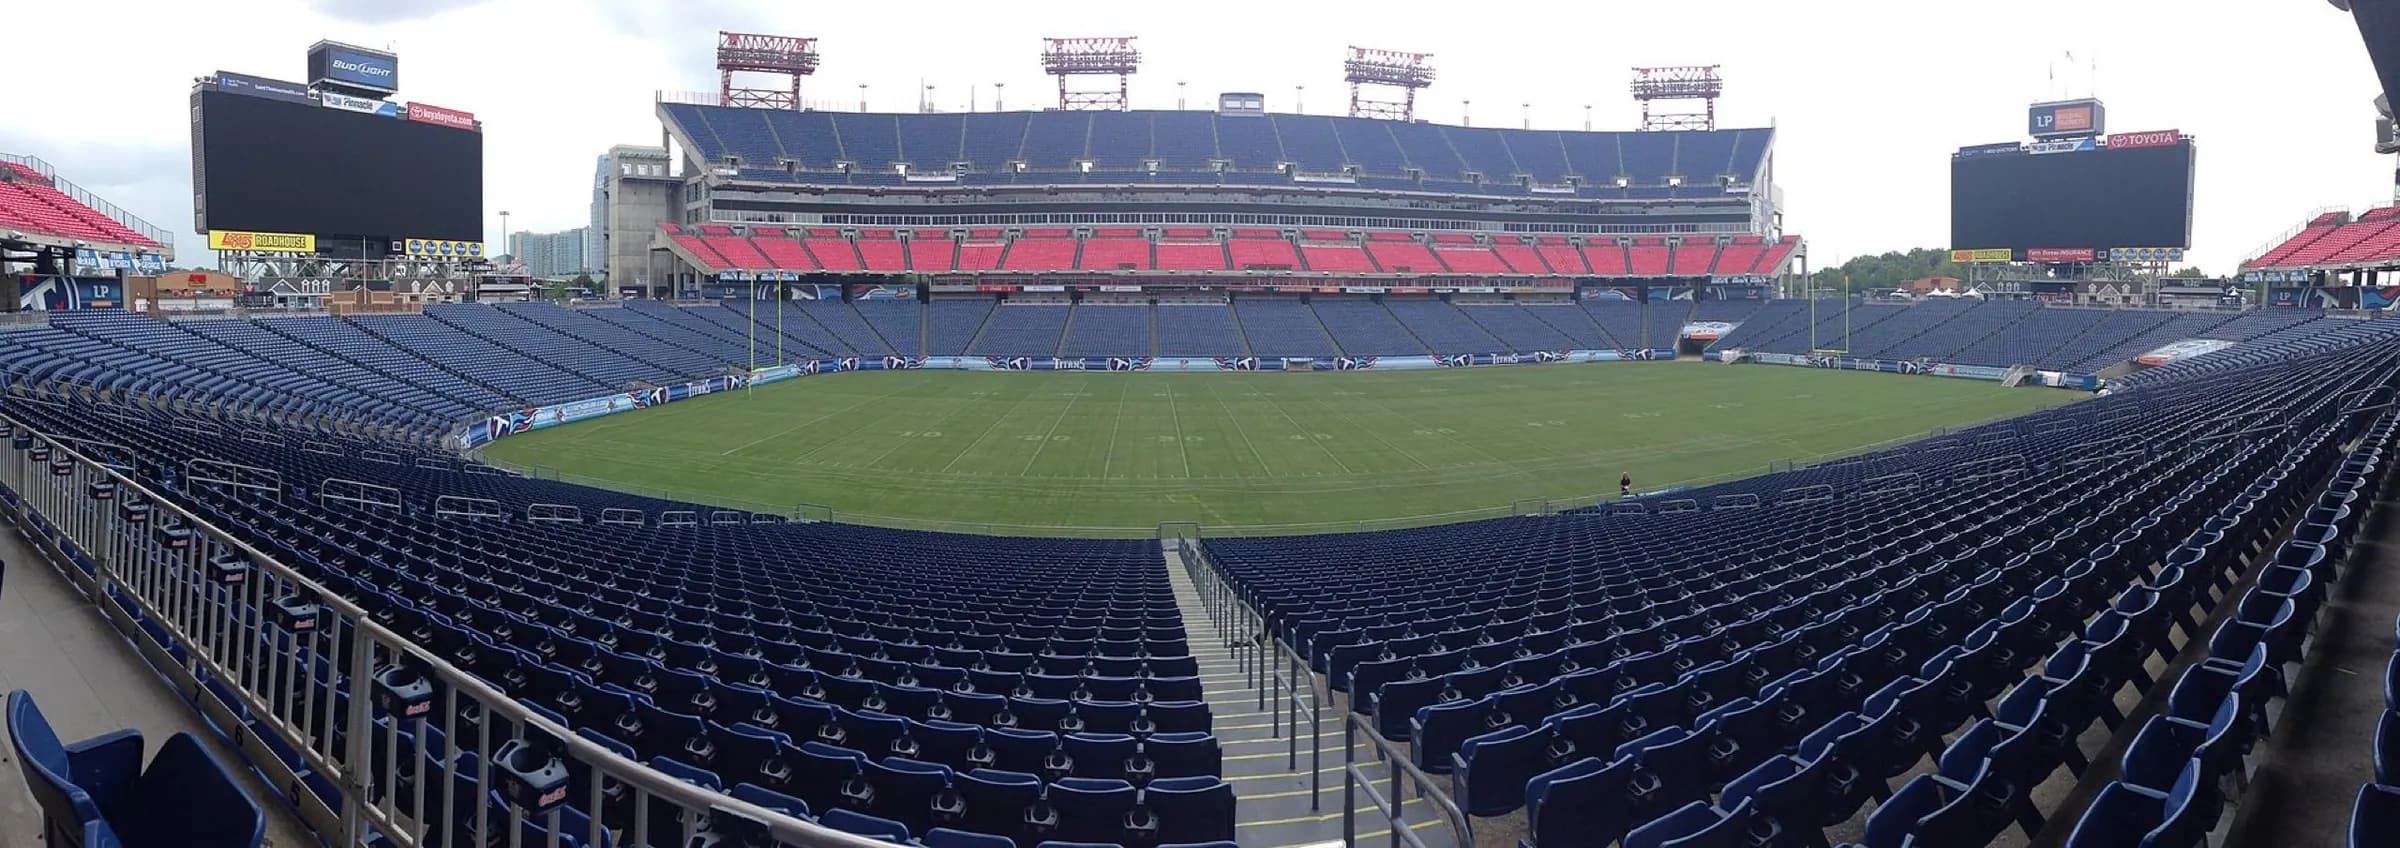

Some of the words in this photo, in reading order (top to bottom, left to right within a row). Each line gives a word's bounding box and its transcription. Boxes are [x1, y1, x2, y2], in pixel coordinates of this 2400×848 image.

[2129, 132, 2173, 145] TOYOTA
[255, 234, 306, 248] ROADHOUSE
[93, 285, 109, 298] LP
